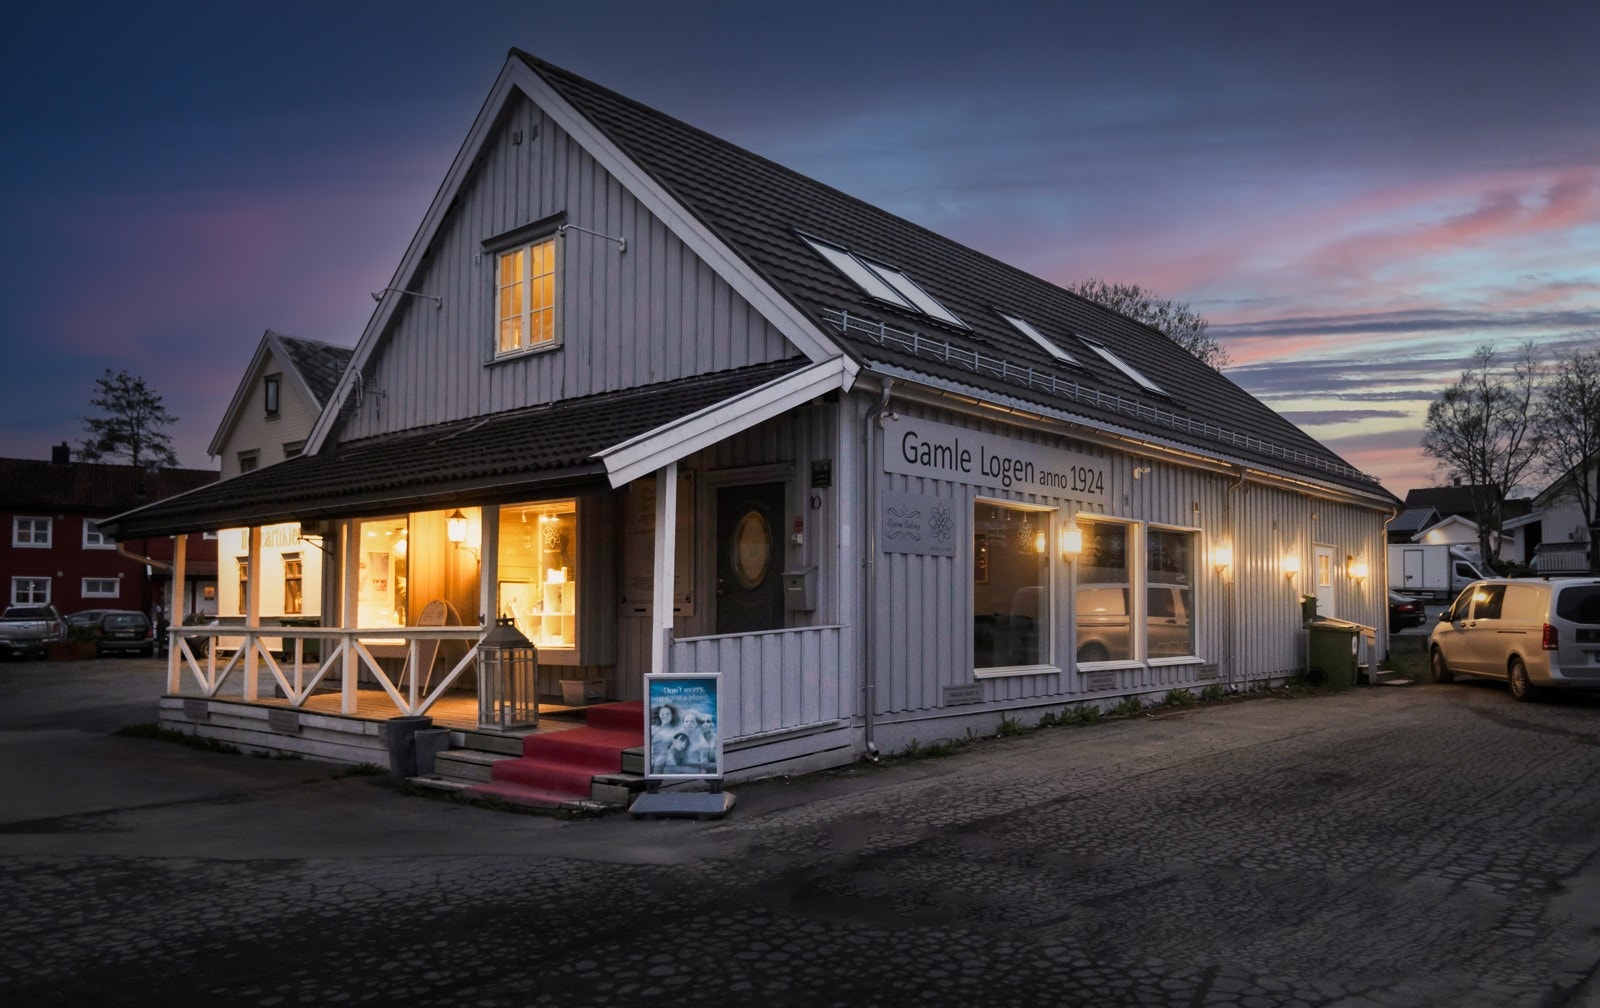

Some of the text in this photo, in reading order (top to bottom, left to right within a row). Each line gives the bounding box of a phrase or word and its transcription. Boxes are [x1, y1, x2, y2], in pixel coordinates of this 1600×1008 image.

[902, 431, 1104, 495] Gamle Logen anno 1924
